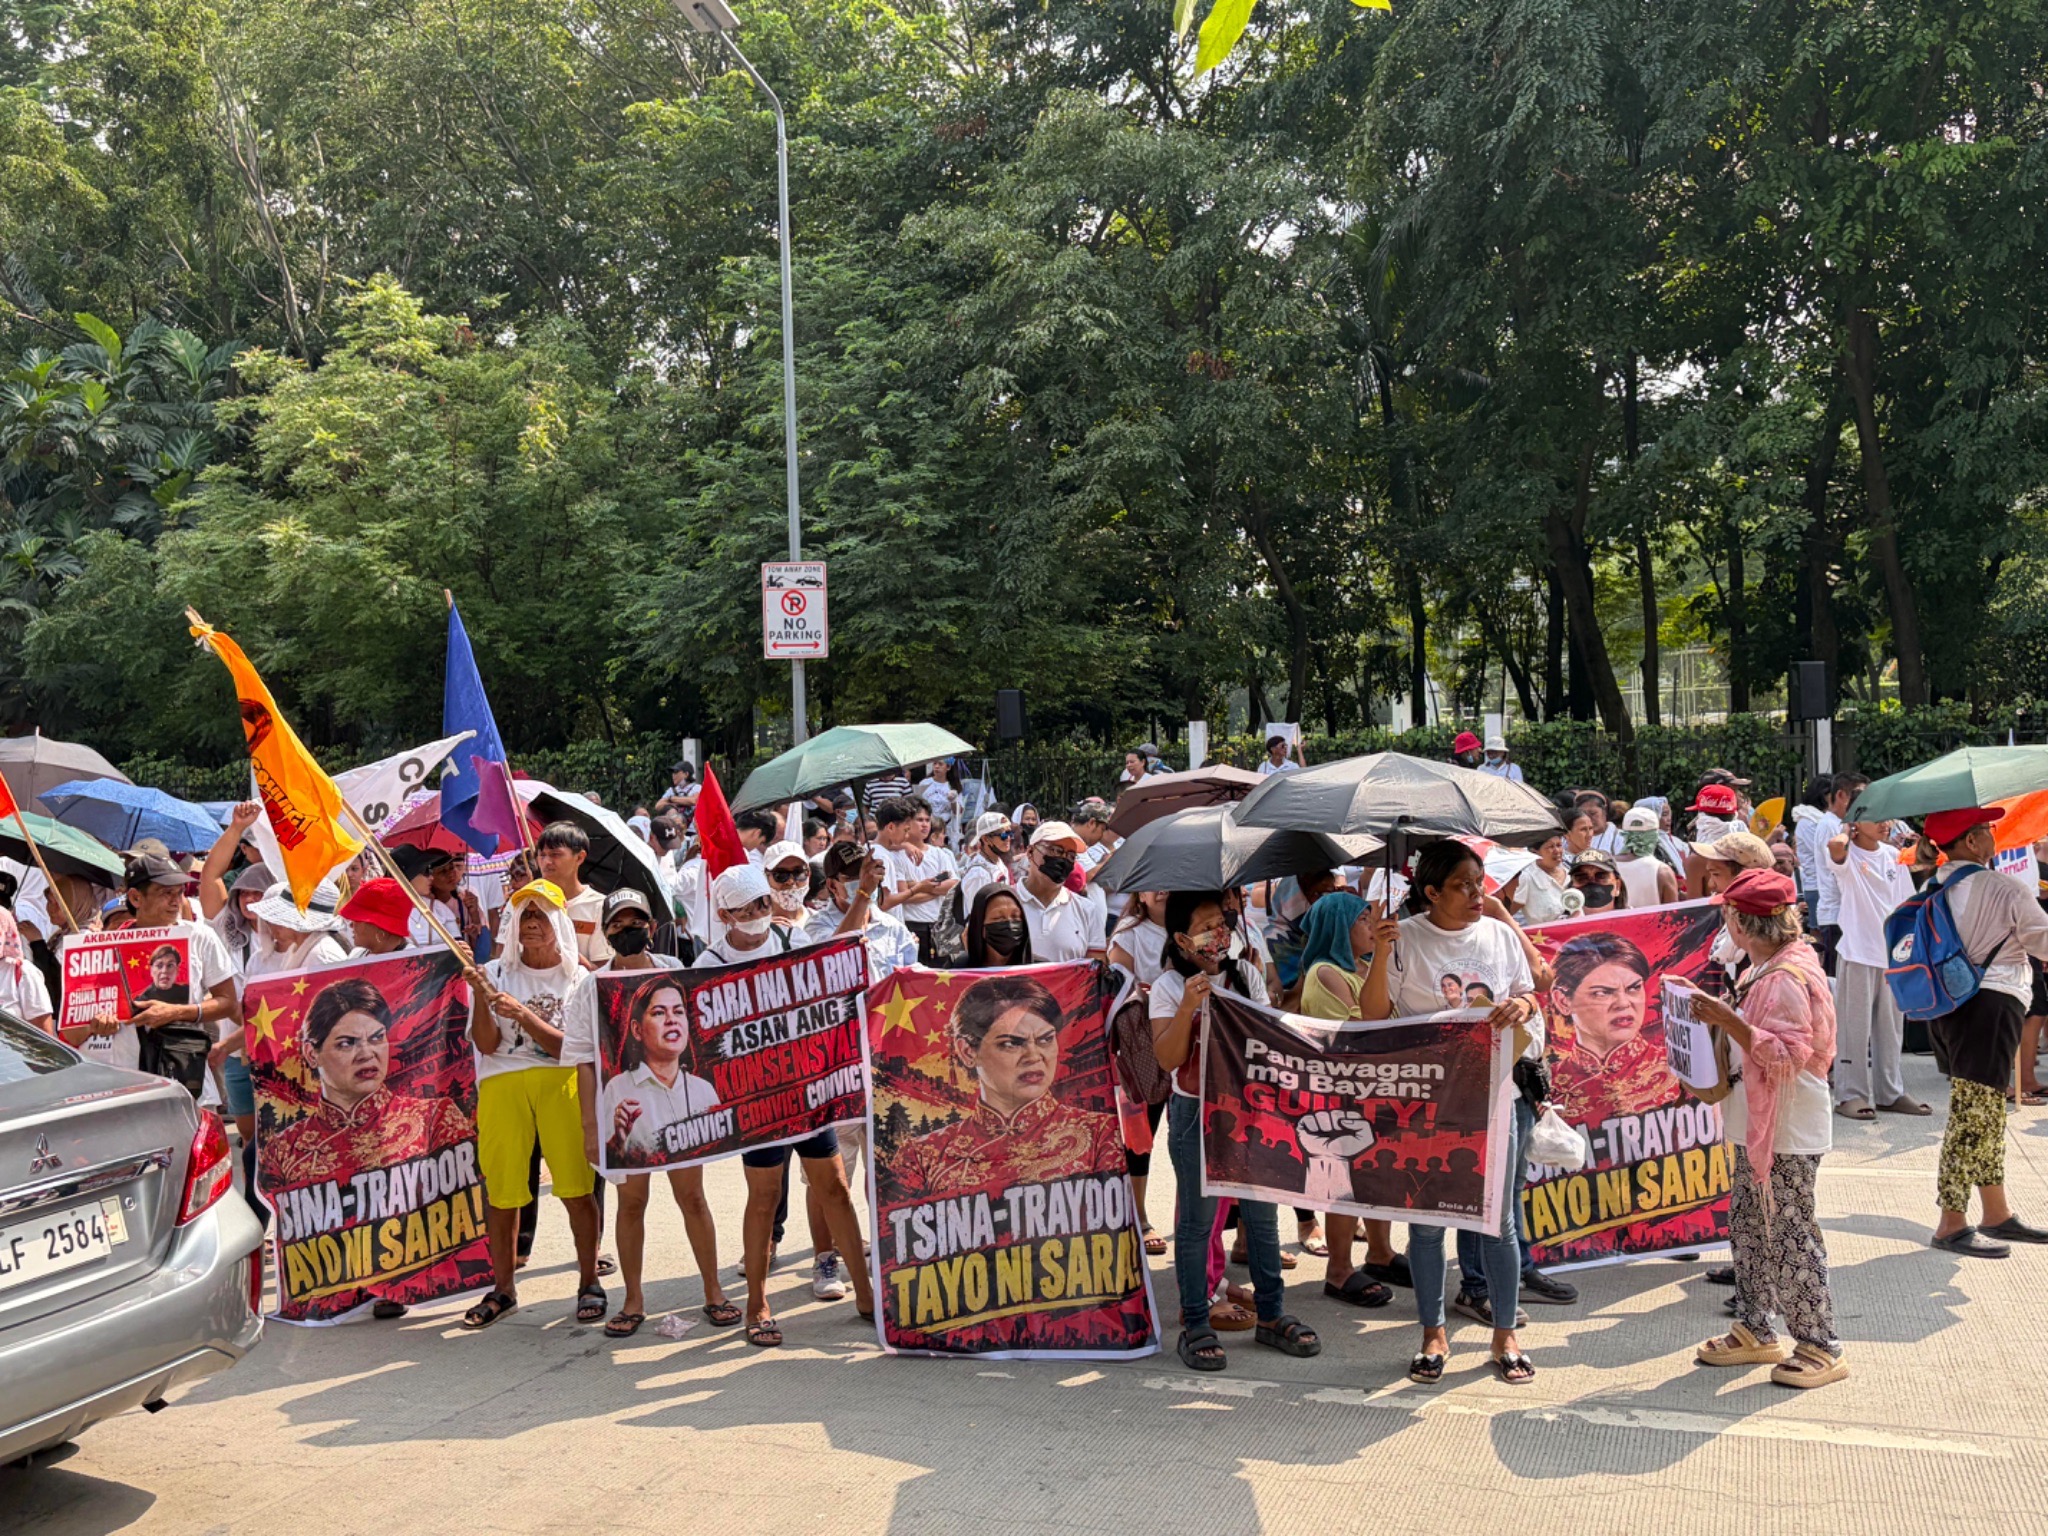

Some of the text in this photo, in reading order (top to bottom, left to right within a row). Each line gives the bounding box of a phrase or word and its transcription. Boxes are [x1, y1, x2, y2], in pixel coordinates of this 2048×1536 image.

[769, 630, 823, 640] PARKING
[784, 618, 807, 630] NO
[83, 928, 171, 944] AKBAYAN PARTY
[69, 985, 119, 1006] CHINA ANG
[696, 947, 864, 1030] SARA INA KA RIN!
[730, 1001, 840, 1051] ASAN ANG
[712, 1019, 860, 1101] KONSENSYA!
[1245, 1037, 1445, 1081] Panawagan
[1308, 1073, 1432, 1101] Bayan:
[664, 1108, 734, 1154] CONVICT
[737, 1086, 806, 1132] CONVICT
[276, 1141, 478, 1242] SINA-TRAYDOR
[1596, 1168, 1632, 1219] NI
[43, 1214, 104, 1260] 2584
[284, 1184, 488, 1297] AYO NI SARA!
[889, 1227, 1143, 1328] TAYO NI SARA!
